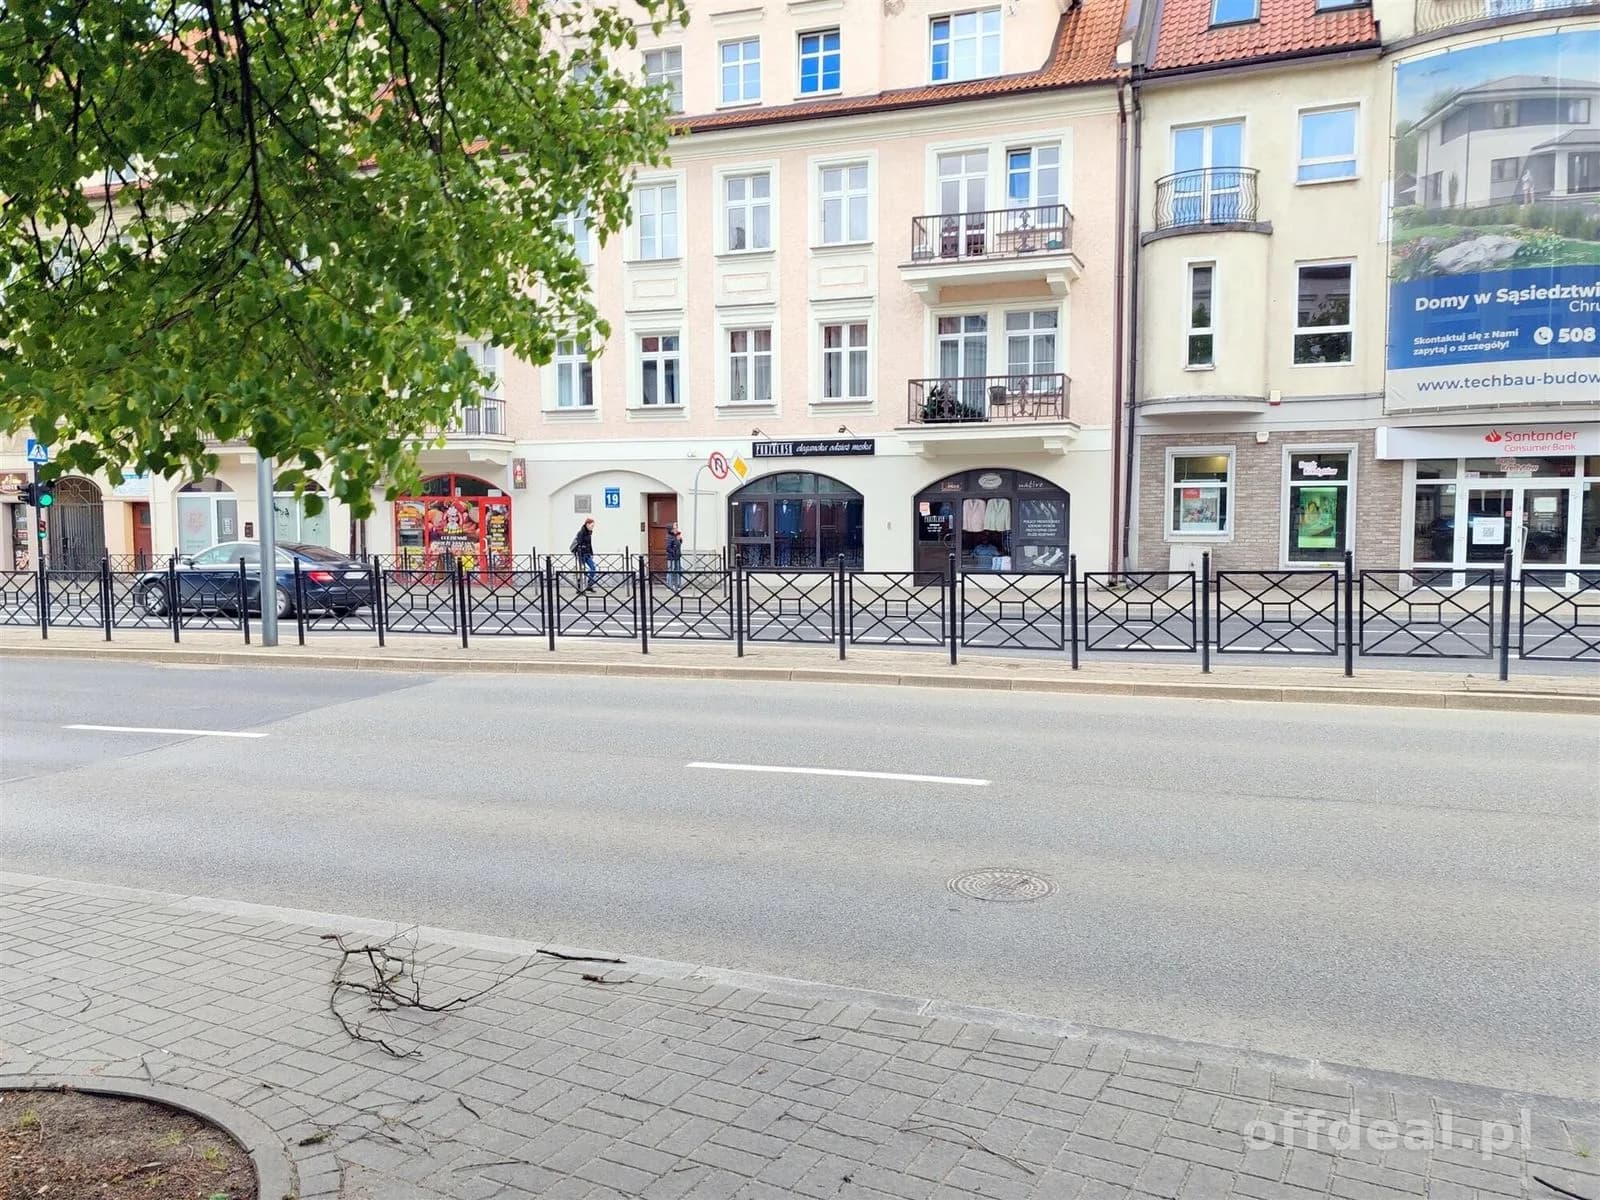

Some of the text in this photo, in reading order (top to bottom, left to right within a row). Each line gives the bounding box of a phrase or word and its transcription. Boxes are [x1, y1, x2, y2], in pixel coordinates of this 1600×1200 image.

[1415, 283, 1600, 312] Domy w Sąsiedztwi
[1414, 327, 1519, 346] Skontaktuj się z Nami
[1558, 327, 1596, 343] 508
[1413, 340, 1510, 357] zapytaj o szczegóły!
[1504, 429, 1579, 443] Santander
[1504, 443, 1576, 453] Consumer Bank
[605, 493, 619, 506] 19
